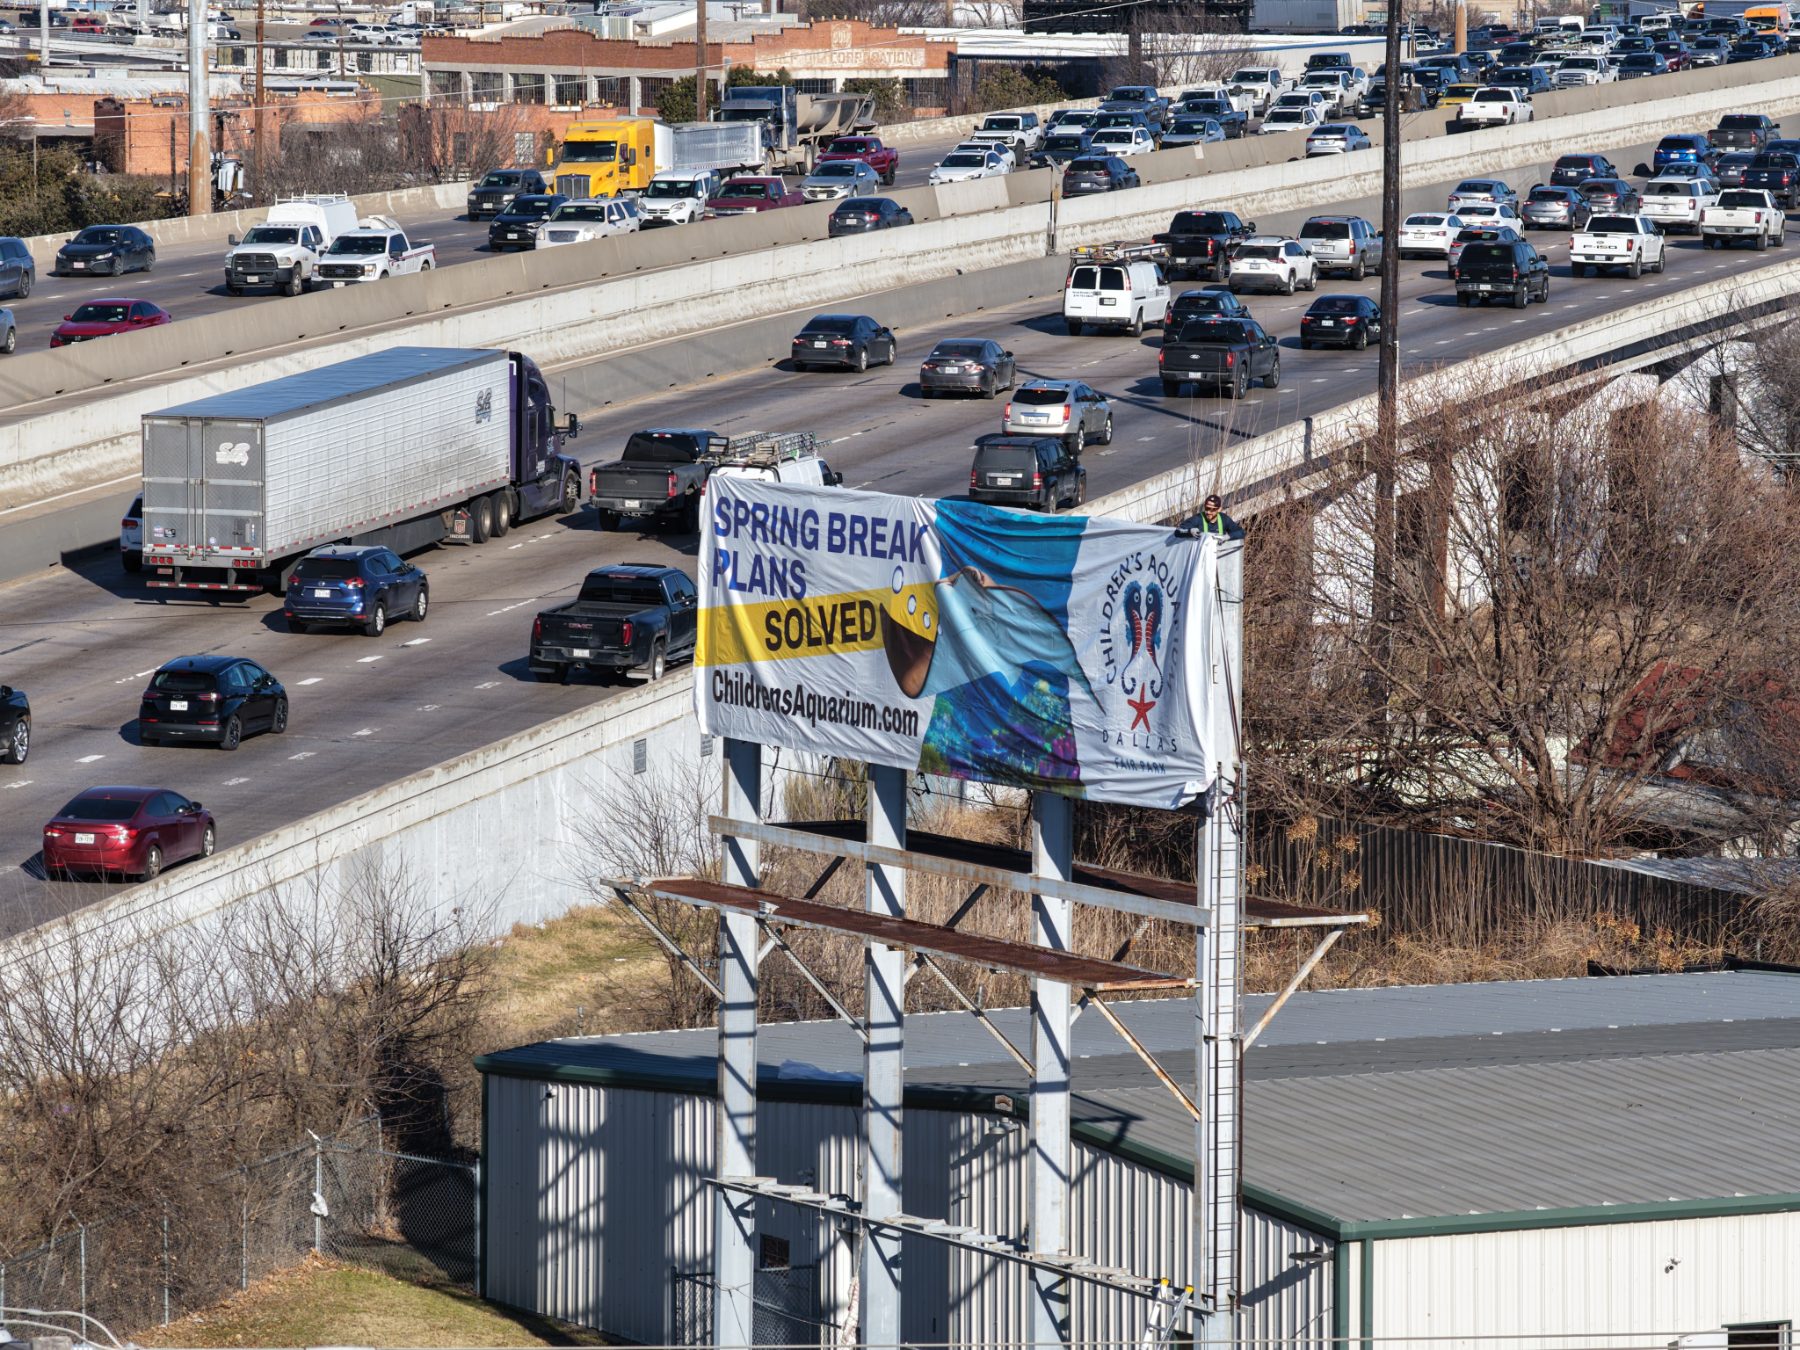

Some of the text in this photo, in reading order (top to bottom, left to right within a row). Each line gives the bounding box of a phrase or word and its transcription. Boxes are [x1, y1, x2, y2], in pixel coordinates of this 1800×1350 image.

[831, 51, 915, 66] CORPORATION
[714, 496, 929, 565] SPRING BREAK
[712, 548, 807, 600] PLANS
[765, 600, 877, 652] SOLVED
[712, 669, 919, 737] ChildrensAquarium.com
[1102, 729, 1178, 753] DALLAS
[1114, 757, 1167, 775] FAIR PARK
